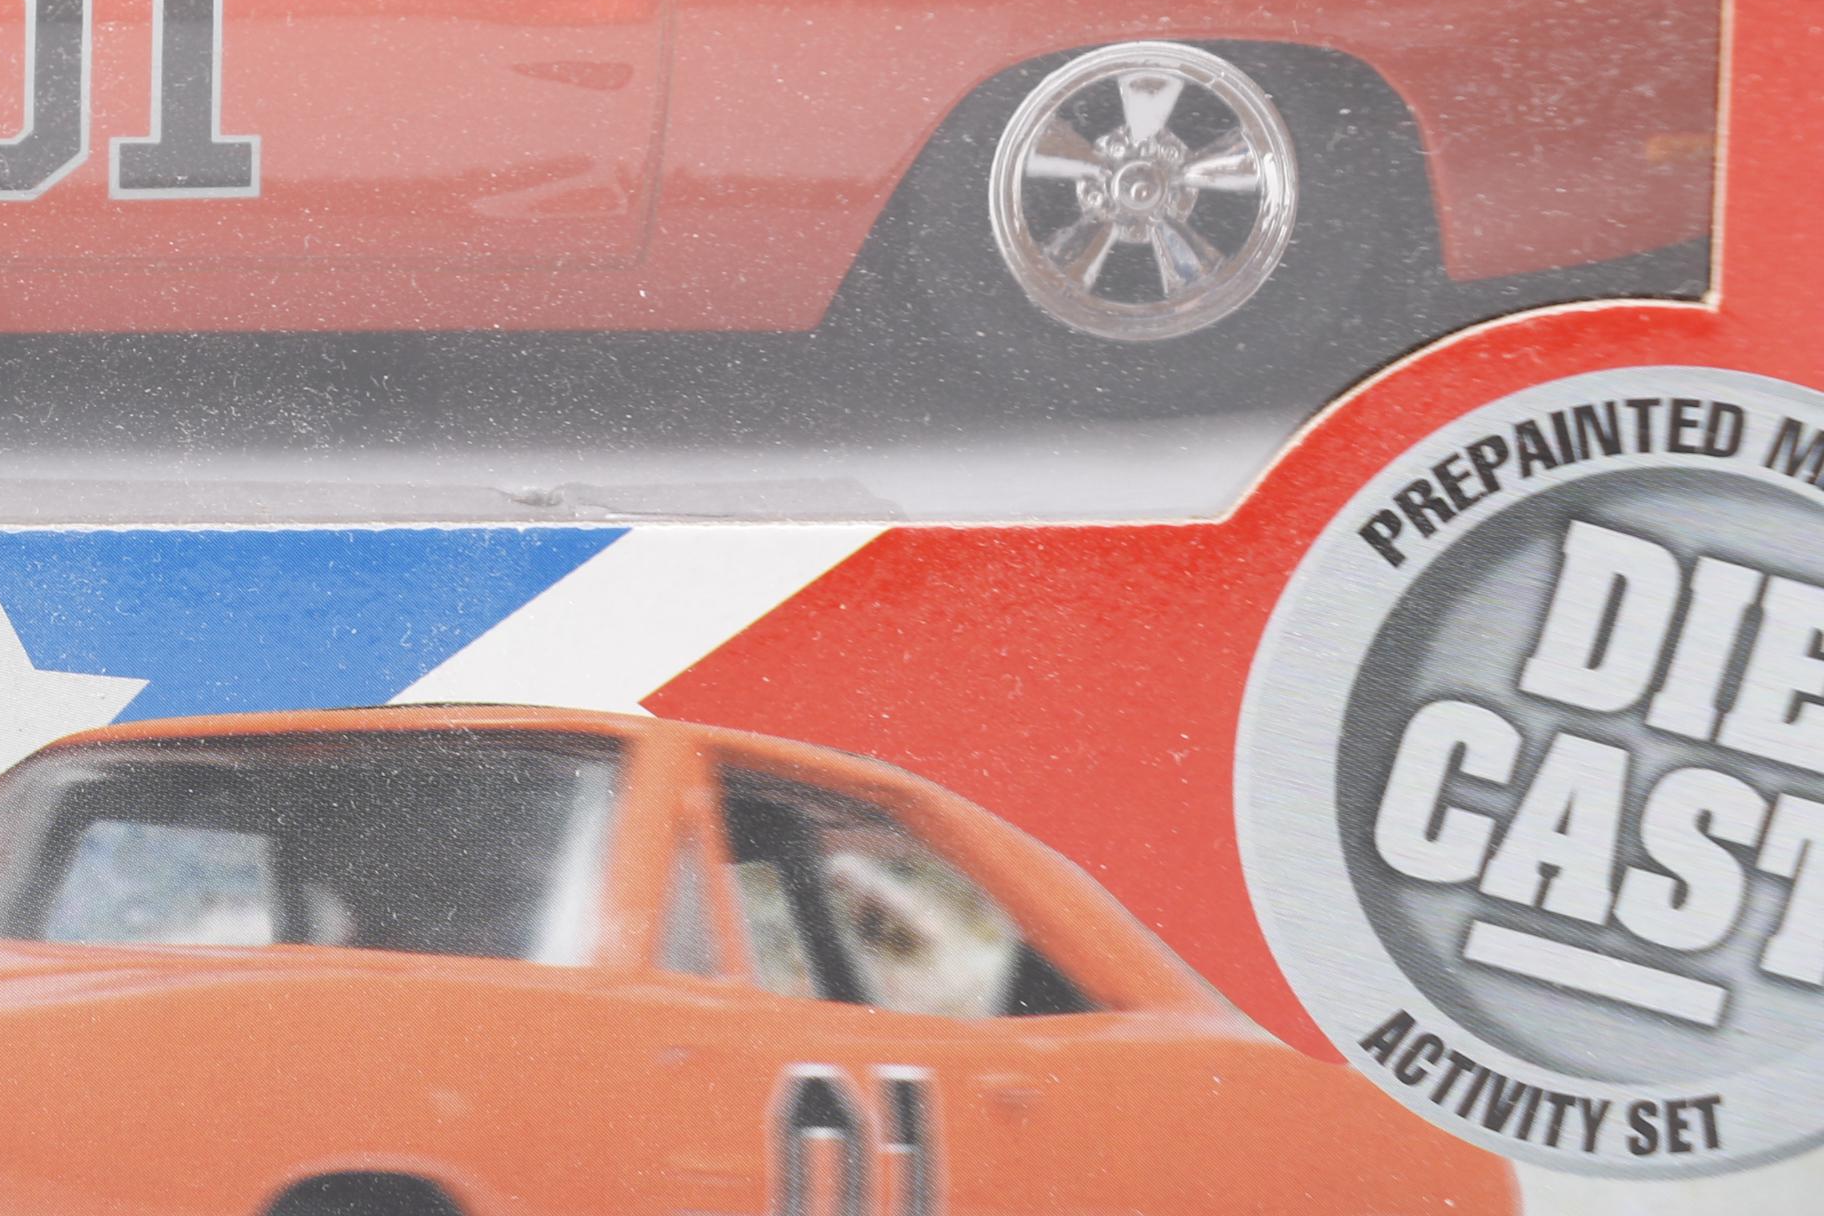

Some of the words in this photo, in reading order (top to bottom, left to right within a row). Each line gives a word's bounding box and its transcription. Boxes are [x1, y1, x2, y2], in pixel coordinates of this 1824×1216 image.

[1357, 397, 1745, 569] PREPAINTED
[1519, 518, 1824, 775] DIE
[1357, 1007, 1612, 1154] ACTIVITY
[1626, 1094, 1722, 1156] SET
